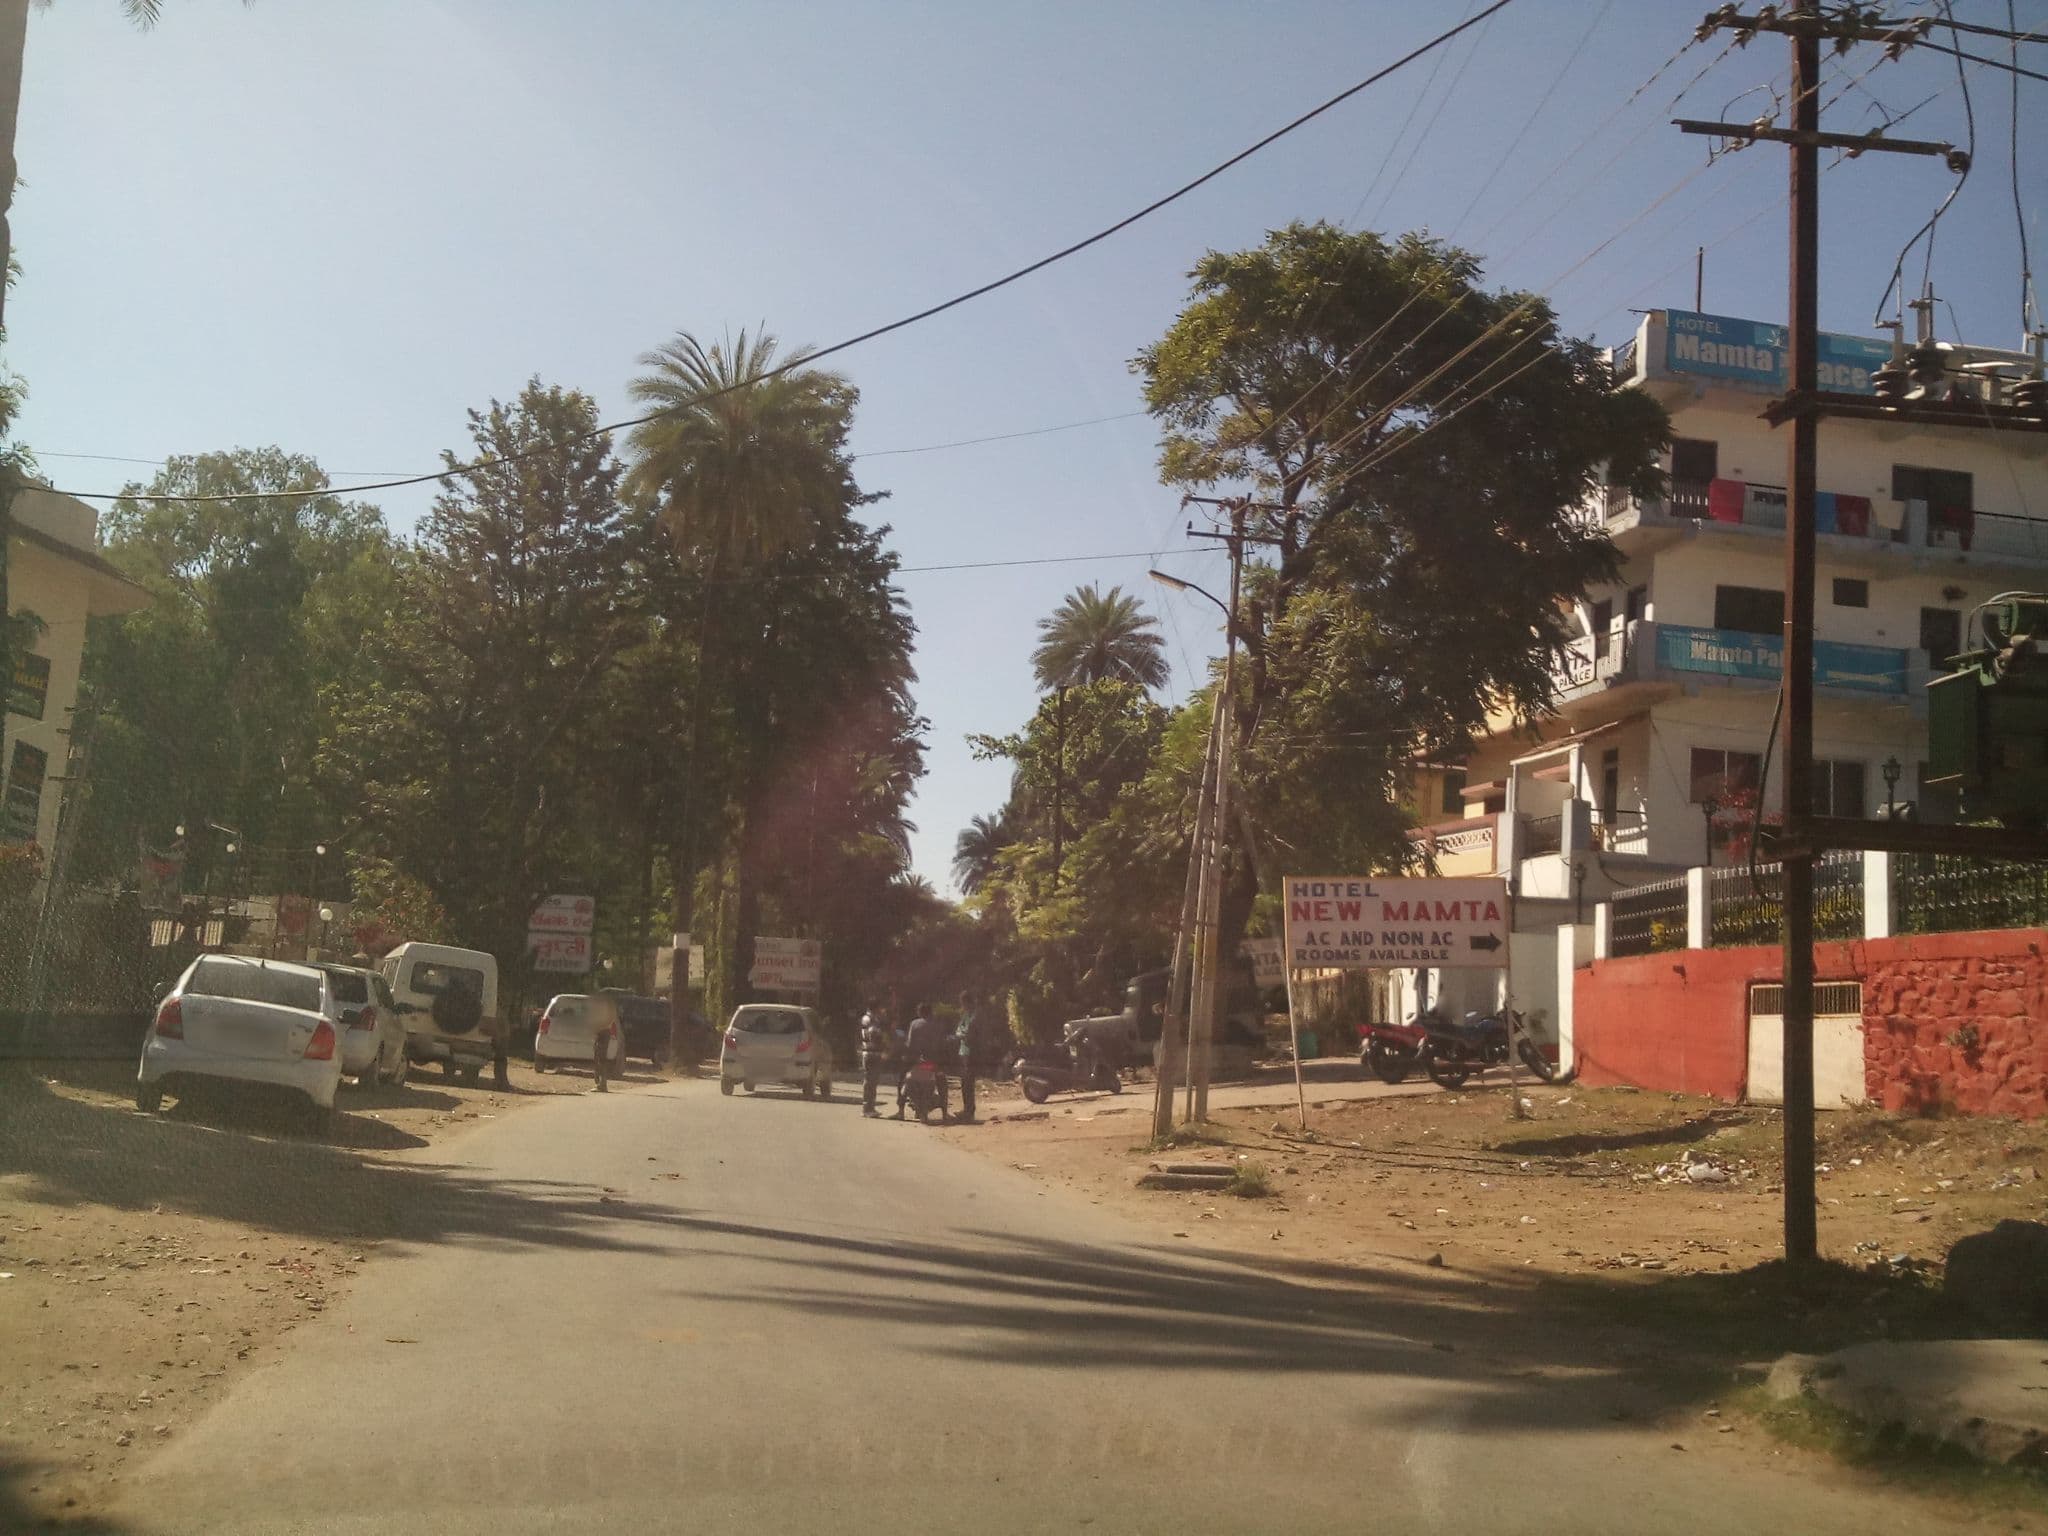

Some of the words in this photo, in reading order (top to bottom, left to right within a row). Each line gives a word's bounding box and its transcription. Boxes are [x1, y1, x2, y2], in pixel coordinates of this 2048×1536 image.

[1676, 316, 1722, 335] HOTEL
[1675, 334, 1773, 372] Mamta
[1292, 882, 1380, 898] HOTEL
[1291, 901, 1362, 922] NEW
[1382, 901, 1502, 922] MAMTA
[1305, 931, 1331, 946] AC
[1340, 931, 1375, 946] AND
[1382, 931, 1424, 946] NON
[1430, 931, 1454, 946] AC
[1296, 948, 1362, 961] ROOMS
[1370, 948, 1449, 961] AVAILABLE
